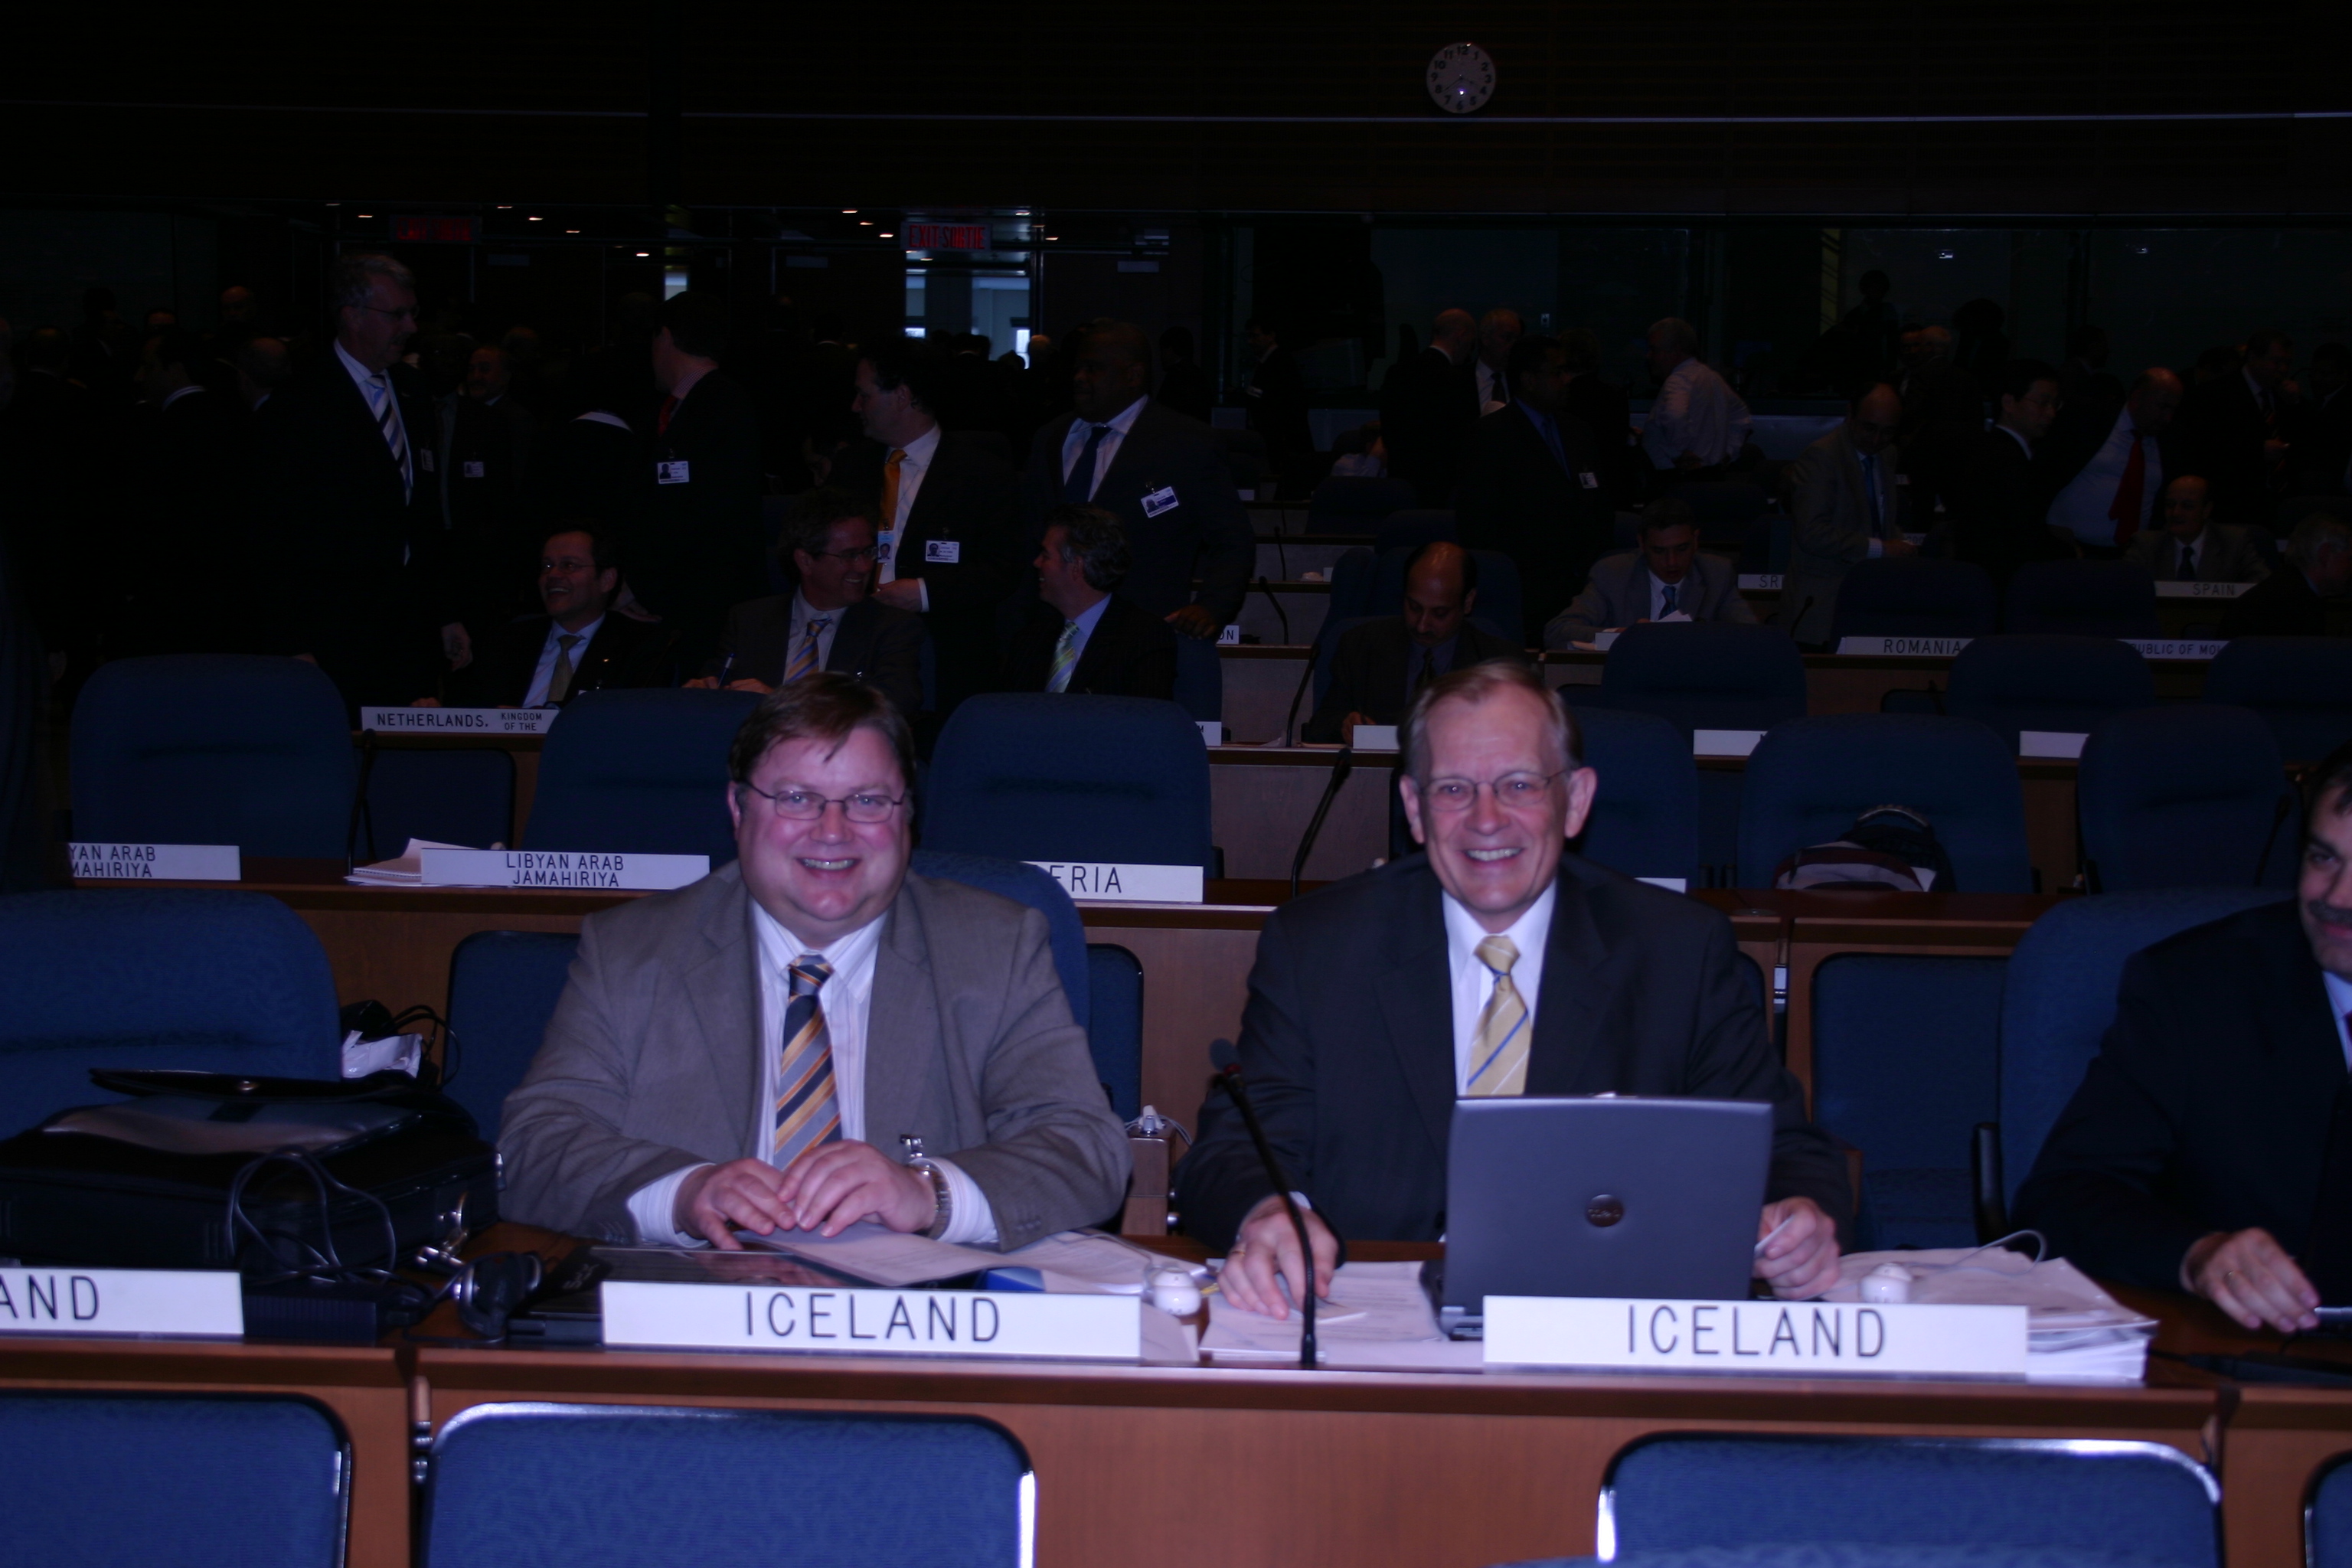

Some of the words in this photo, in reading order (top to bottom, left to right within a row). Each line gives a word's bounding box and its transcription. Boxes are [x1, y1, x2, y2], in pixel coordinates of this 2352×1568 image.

[1444, 50, 1453, 60] 11
[1457, 46, 1468, 55] 12
[1475, 51, 1479, 60] 1
[1434, 60, 1446, 70] 10
[1481, 62, 1488, 71] 2
[1431, 72, 1438, 83] 9
[1485, 74, 1492, 83] 3
[1435, 84, 1442, 93] 8
[1444, 95, 1452, 105] 7
[1456, 100, 1463, 110] 6
[1470, 96, 1476, 106] 5
[2193, 583, 2235, 596] SPAIN
[1883, 639, 1961, 655] ROMANIA
[2178, 644, 2194, 655] OF
[501, 712, 542, 720] KINGDOM
[504, 722, 514, 730] OF
[519, 722, 537, 731] THE
[111, 845, 155, 861] ARAB
[506, 852, 570, 869] LIBYAN
[578, 854, 624, 871] ARAB
[513, 870, 619, 887] JAMAHIRIYA
[746, 1291, 1001, 1342] ICELAND
[1628, 1304, 1886, 1357] ICELAND
